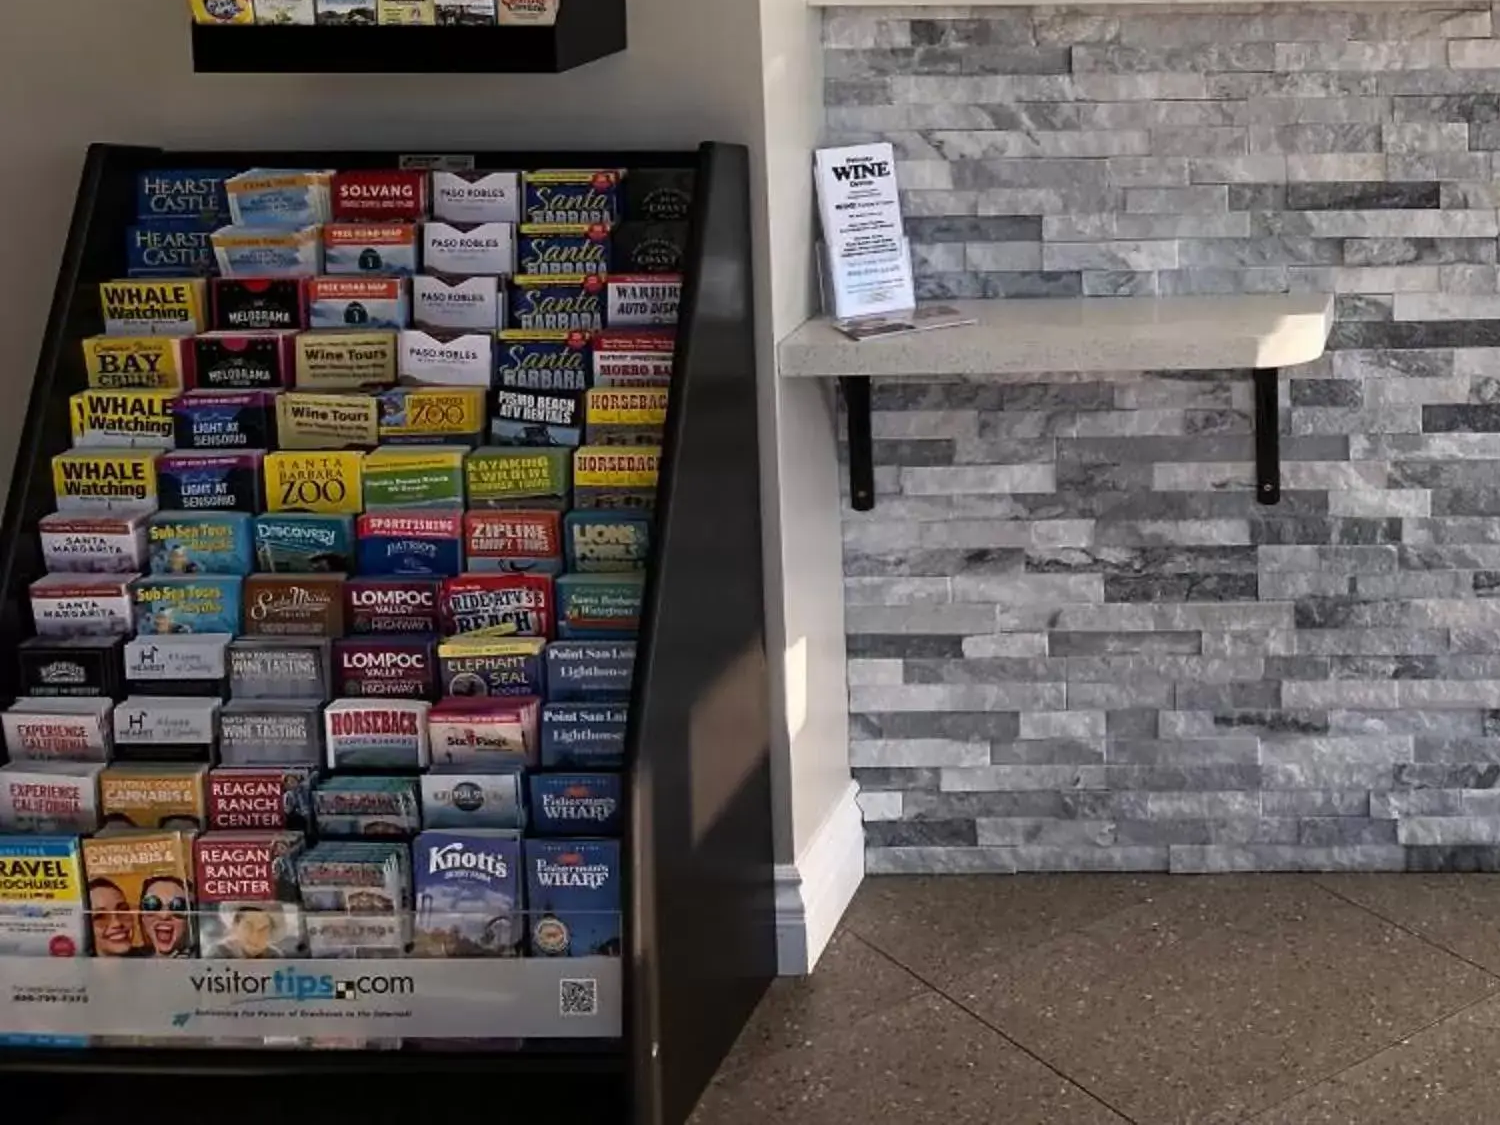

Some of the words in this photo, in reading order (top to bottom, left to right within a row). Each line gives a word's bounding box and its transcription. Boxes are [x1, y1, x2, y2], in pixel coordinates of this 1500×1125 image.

[832, 161, 891, 181] WINE
[144, 177, 220, 195] HEARST
[340, 184, 413, 198] SOLVANG
[441, 188, 465, 198] PASO
[150, 194, 220, 213] CASTLE
[529, 187, 608, 214] Santa
[135, 231, 210, 249] HEARST
[431, 238, 457, 249] PASO
[460, 238, 499, 249] ROBLES
[142, 248, 211, 266] CASTLE
[521, 238, 606, 263] Santa
[104, 286, 186, 305] WHALE
[421, 292, 445, 302] PASO
[514, 290, 600, 316] Santa
[107, 306, 189, 321] Watching
[521, 312, 603, 330] BARBARA
[304, 347, 345, 362] Wine
[348, 348, 388, 363] Tours
[410, 347, 435, 359] PASO
[499, 345, 584, 372] Santa
[97, 352, 164, 374] BAY
[600, 364, 648, 376] MORRO
[502, 368, 587, 389] BARBARA
[88, 394, 175, 417] WHALE
[499, 390, 536, 408] PISMO
[291, 406, 329, 422] Wine
[332, 408, 370, 423] Tours
[412, 404, 466, 425] ZOO
[88, 416, 174, 438] Watching
[61, 462, 145, 481] WHALE
[277, 459, 344, 470] SANTA
[278, 469, 345, 483] BARBARA
[63, 481, 147, 500] Watching
[215, 481, 230, 494] AT
[281, 479, 346, 505] ZOO
[369, 518, 455, 532] SPORTFISHING
[472, 523, 548, 540] ZIPLINE
[66, 537, 108, 546] SANTA
[53, 546, 123, 554] MARGARITA
[138, 589, 162, 603] Sub
[351, 590, 433, 607] LOMPOC
[452, 593, 493, 614] RIDE
[43, 610, 117, 619] MARGARITA
[57, 602, 101, 611] SANTA
[343, 653, 425, 669] LOMPOC
[549, 649, 580, 661] Point
[583, 650, 607, 661] San
[447, 657, 526, 673] ELEPHANT
[490, 672, 529, 686] SEAL
[361, 683, 415, 695] HIGHWAY
[332, 710, 418, 736] HORSEBACK
[542, 710, 574, 723] Point
[577, 711, 604, 723] San
[16, 725, 89, 739] EXPERIENCE
[10, 783, 81, 799] EXPERIENCE
[105, 789, 182, 802] CANNABIS
[212, 782, 281, 797] REAGAN
[216, 799, 279, 813] RANCH
[216, 815, 281, 829] CENTER
[543, 806, 616, 824] WHARF
[87, 852, 162, 866] CANNABIS
[200, 849, 271, 863] REAGAN
[429, 842, 508, 879] Knott's
[204, 865, 268, 879] RANCH
[204, 880, 271, 895] CENTER
[537, 872, 611, 889] WHARF
